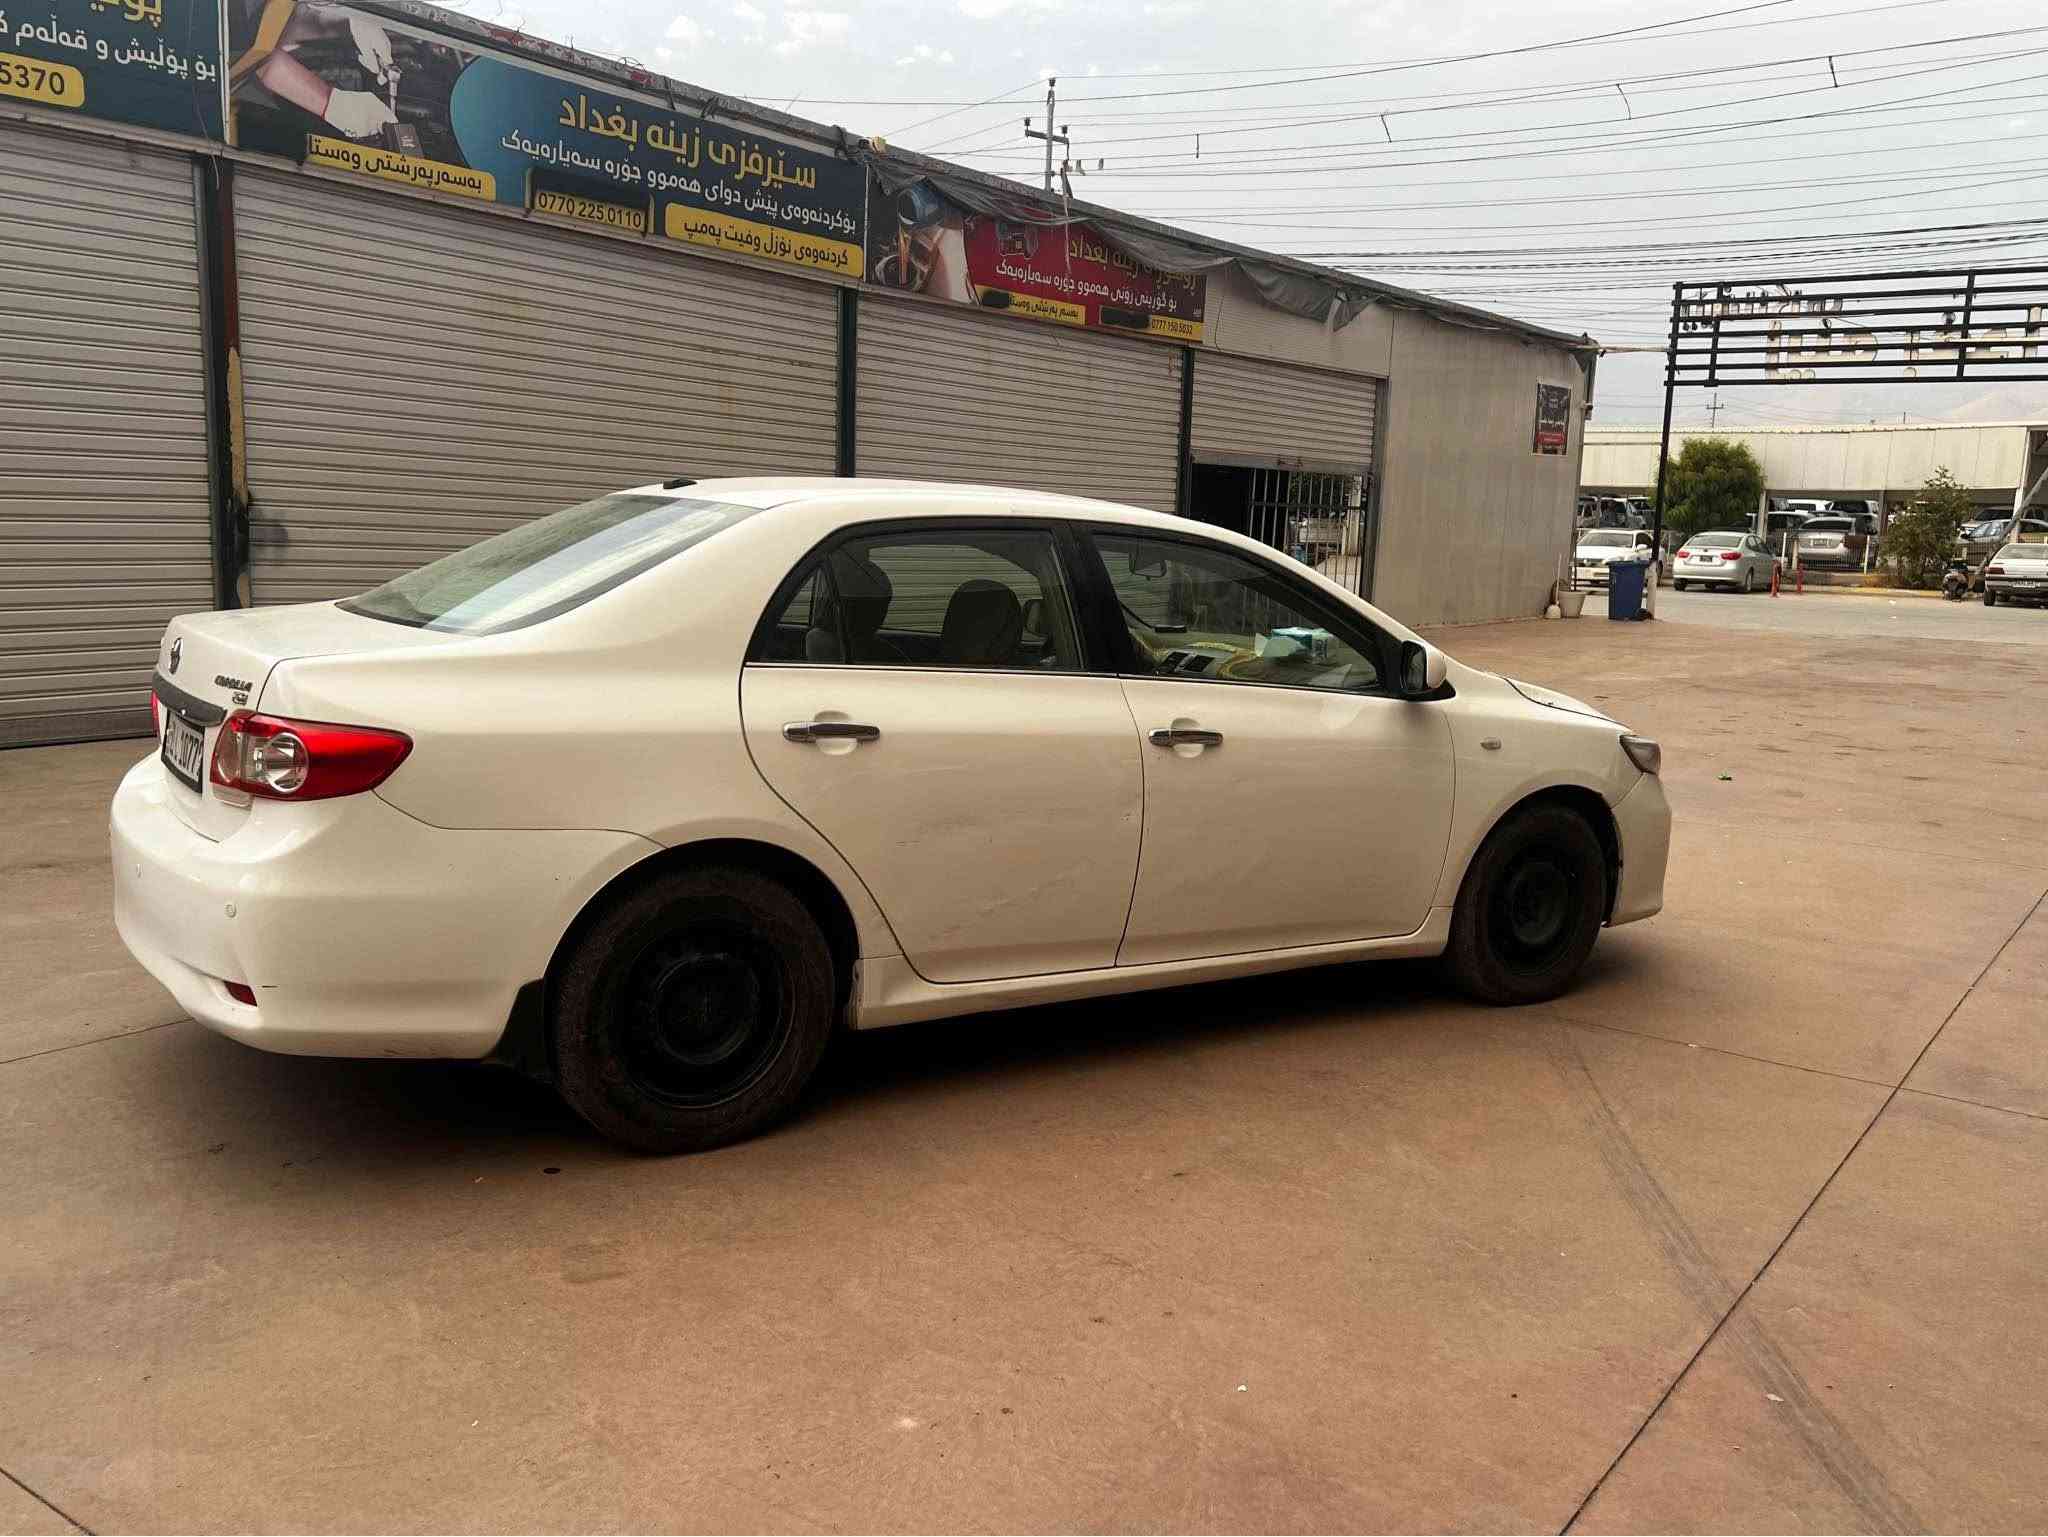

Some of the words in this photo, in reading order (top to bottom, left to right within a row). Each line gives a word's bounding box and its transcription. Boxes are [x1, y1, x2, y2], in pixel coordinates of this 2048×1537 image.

[559, 95, 638, 152] بغداد
[538, 191, 576, 214] 0770
[578, 197, 604, 221] 225
[607, 203, 642, 228] 0110
